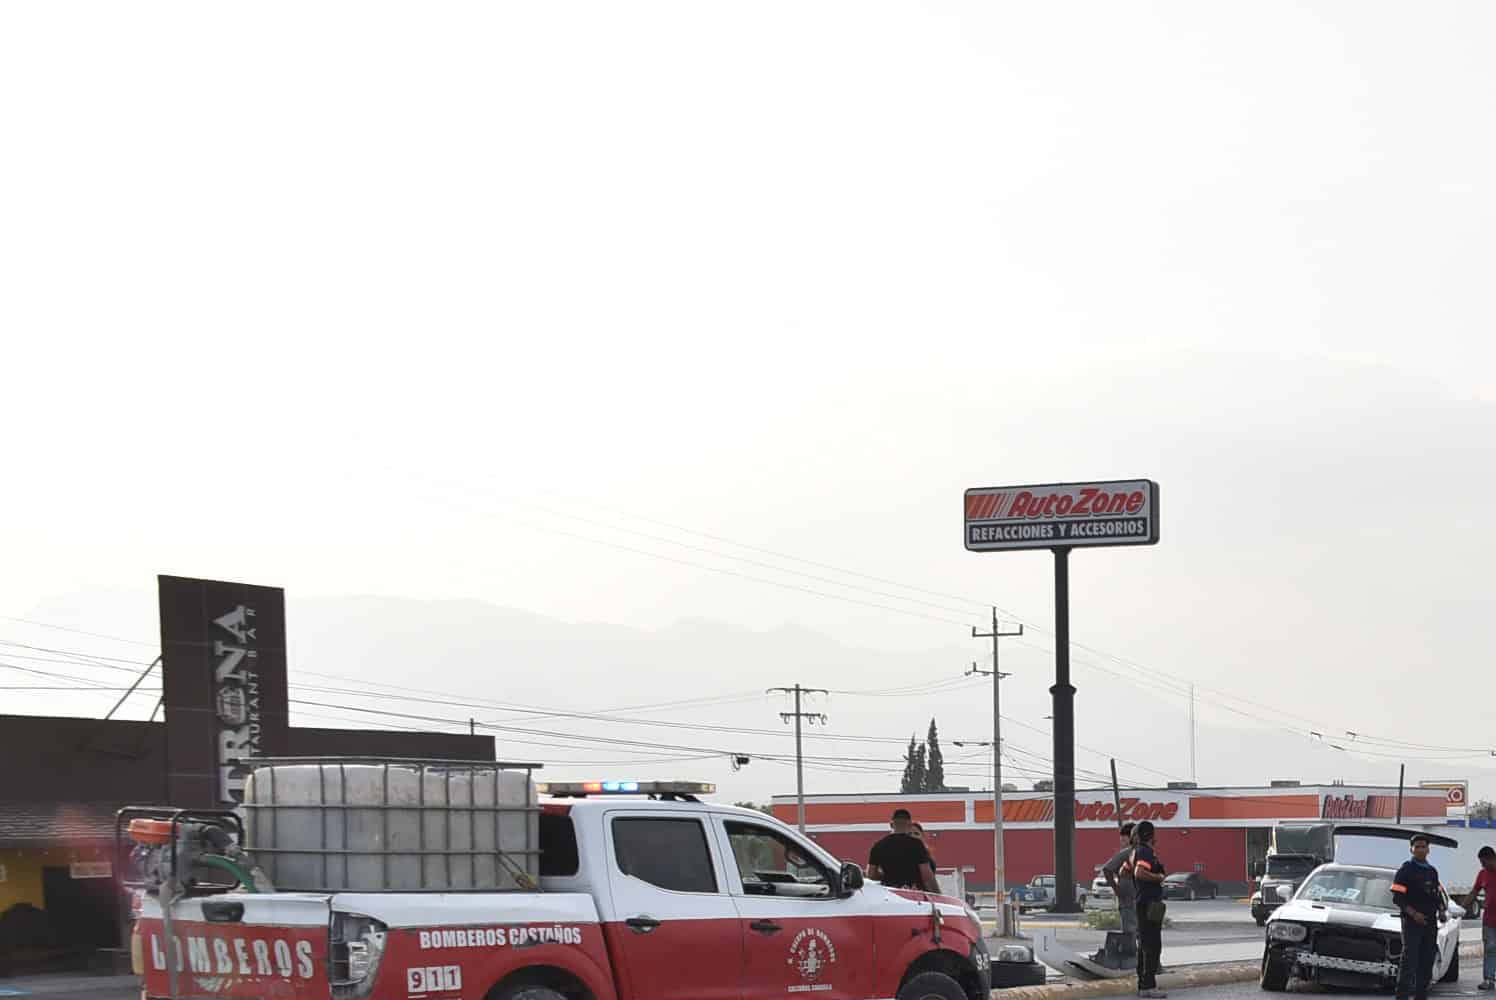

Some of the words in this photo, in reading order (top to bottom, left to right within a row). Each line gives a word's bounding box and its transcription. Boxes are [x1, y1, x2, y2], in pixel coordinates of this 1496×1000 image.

[1007, 487, 1146, 519] AutoZone
[972, 524, 1054, 541] REFACCIONES
[1058, 524, 1068, 537] Y
[1070, 520, 1144, 536] ACCESORIOS
[1075, 797, 1178, 821] utoZone
[419, 930, 507, 949] BOMBEROS
[509, 925, 582, 945] CASTAÑOS
[409, 966, 460, 990] 911
